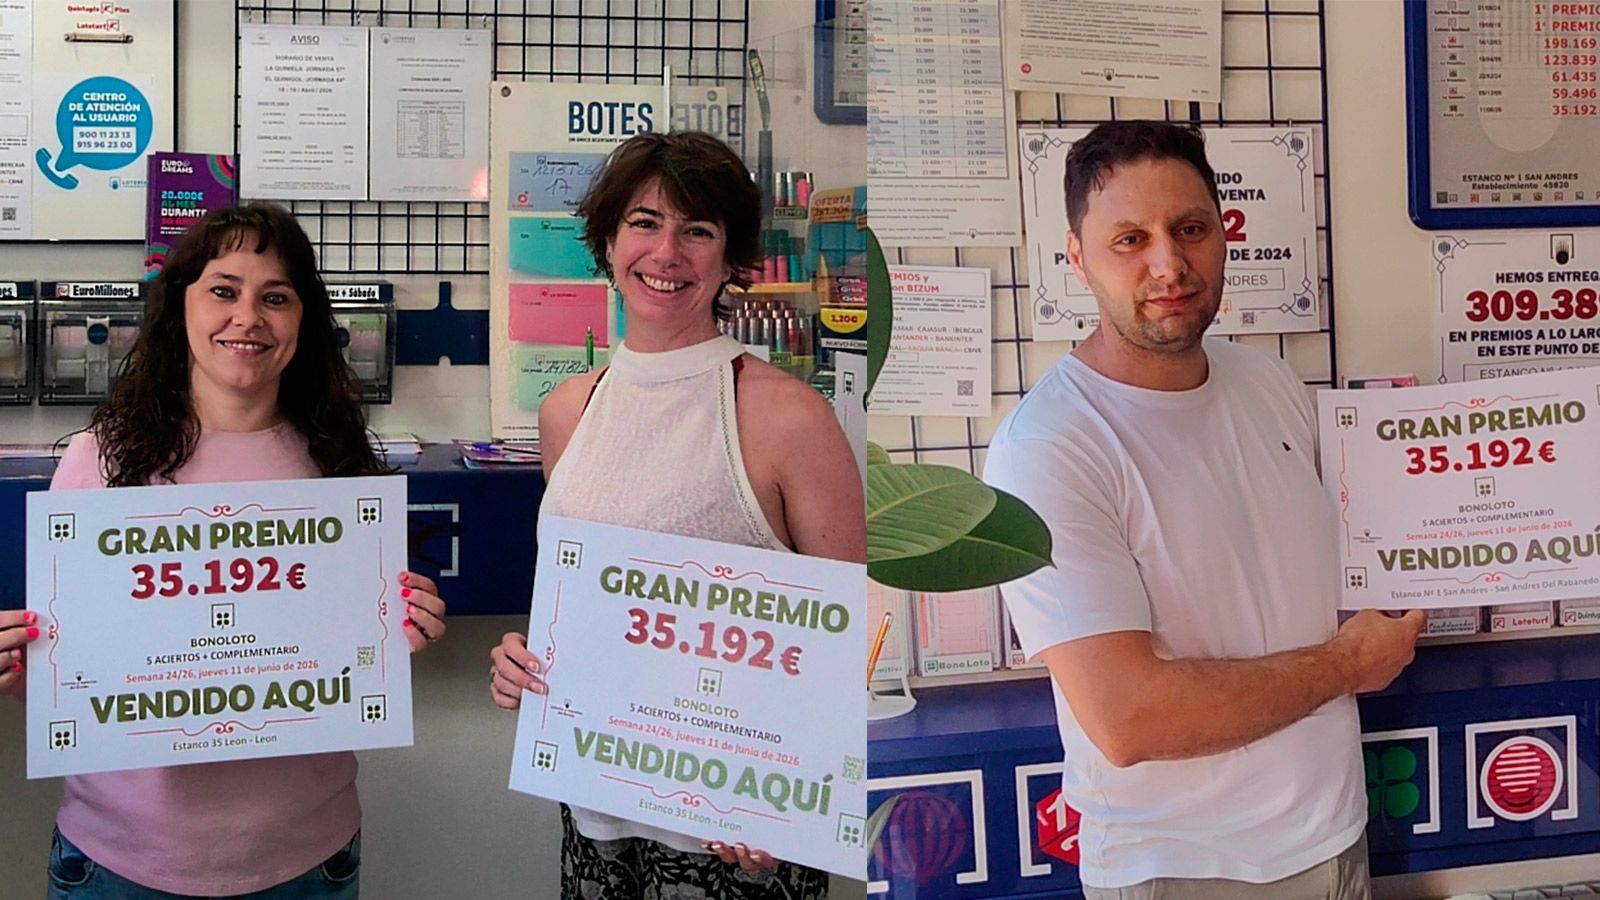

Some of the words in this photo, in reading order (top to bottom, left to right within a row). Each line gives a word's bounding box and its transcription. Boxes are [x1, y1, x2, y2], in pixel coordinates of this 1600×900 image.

[290, 34, 320, 45] AVISO
[1544, 38, 1597, 49] 198.169
[1544, 54, 1597, 66] 123.839
[1552, 72, 1597, 82] 61.435
[82, 92, 127, 102] CENTRO
[1552, 88, 1597, 99] 59.496
[68, 102, 84, 112] DE
[86, 101, 140, 112] ATENCIÓN
[1552, 104, 1597, 116] 35.192
[72, 112, 87, 122] AL
[88, 113, 138, 122] USUARIO
[568, 101, 653, 136] BOTES
[78, 131, 98, 139] 900
[100, 131, 107, 139] 11
[108, 131, 120, 139] 23
[1218, 189, 1266, 201] VENTA
[1222, 208, 1246, 242] 2
[1229, 248, 1250, 260] DE
[1254, 248, 1292, 260] 2024
[1496, 272, 1544, 284] HEMOS
[1548, 270, 1600, 282] ENTREG
[72, 284, 134, 297] EuroMillones
[906, 284, 940, 293] BIZUM
[1464, 288, 1600, 322] 309.38
[1449, 332, 1468, 342] EN
[1470, 330, 1534, 342] PREMIOS
[1536, 330, 1546, 340] A
[1550, 328, 1566, 340] LO
[1477, 346, 1495, 357] EN
[1499, 345, 1531, 356] ESTE
[1534, 344, 1578, 355] PUNTO
[1582, 343, 1600, 354] DE
[1376, 414, 1462, 442] GRAN
[1469, 400, 1586, 434] PREMIO
[1458, 500, 1516, 514] BONOLOTO
[1429, 517, 1468, 526] ACIERTOS
[1476, 508, 1554, 523] COMPLEMENTARIO
[98, 524, 200, 556] GRAN
[209, 516, 343, 549] PREMIO
[1406, 532, 1438, 540] Semana
[1467, 528, 1494, 538] jueves
[1506, 526, 1517, 534] de
[1518, 524, 1540, 534] junio
[1540, 522, 1550, 530] de
[1552, 520, 1573, 530] 2026
[1377, 541, 1518, 572] VENDIDO
[1391, 590, 1422, 600] Estanco
[1443, 588, 1457, 596] San
[1460, 586, 1488, 595] Andres
[1495, 584, 1510, 593] San
[1512, 581, 1540, 592] Andres
[1558, 576, 1599, 588] Rabanedo
[600, 566, 699, 608] GRAN
[706, 582, 850, 633] PREMIO
[190, 634, 256, 648] BONOLOTO
[146, 657, 152, 665] 5
[154, 652, 200, 664] ACIERTOS
[210, 646, 300, 660] COMPLEMENTARIO
[126, 673, 164, 684] Semana
[166, 669, 196, 680] 24/26,
[198, 668, 228, 679] jueves
[232, 666, 242, 674] 11
[244, 664, 256, 674] de
[258, 664, 282, 674] junio
[282, 662, 295, 671] de
[297, 660, 319, 670] 2026
[90, 683, 255, 724] VENDIDO
[262, 666, 351, 712] AQUÍ
[673, 697, 740, 719] BONOLOTO
[630, 703, 636, 712] 5
[638, 704, 681, 722] ACIERTOS
[690, 716, 782, 744] COMPLEMENTARIO
[173, 741, 208, 751] Estanco
[212, 738, 222, 748] 35
[224, 738, 248, 746] Leon
[255, 735, 278, 744] Leon
[608, 716, 644, 731] Semana
[645, 724, 673, 738] 24/26,
[676, 730, 706, 745] jueves
[708, 738, 718, 748] 11
[721, 740, 733, 751] de
[735, 744, 759, 758] junio
[761, 748, 774, 760] de
[776, 752, 800, 766] 2026
[573, 727, 728, 790] VENDIDO
[733, 767, 832, 816] AQUÍ
[640, 798, 674, 815] Estanco
[676, 808, 686, 818] 35
[688, 811, 711, 824] Leon
[719, 818, 742, 832] Leon
